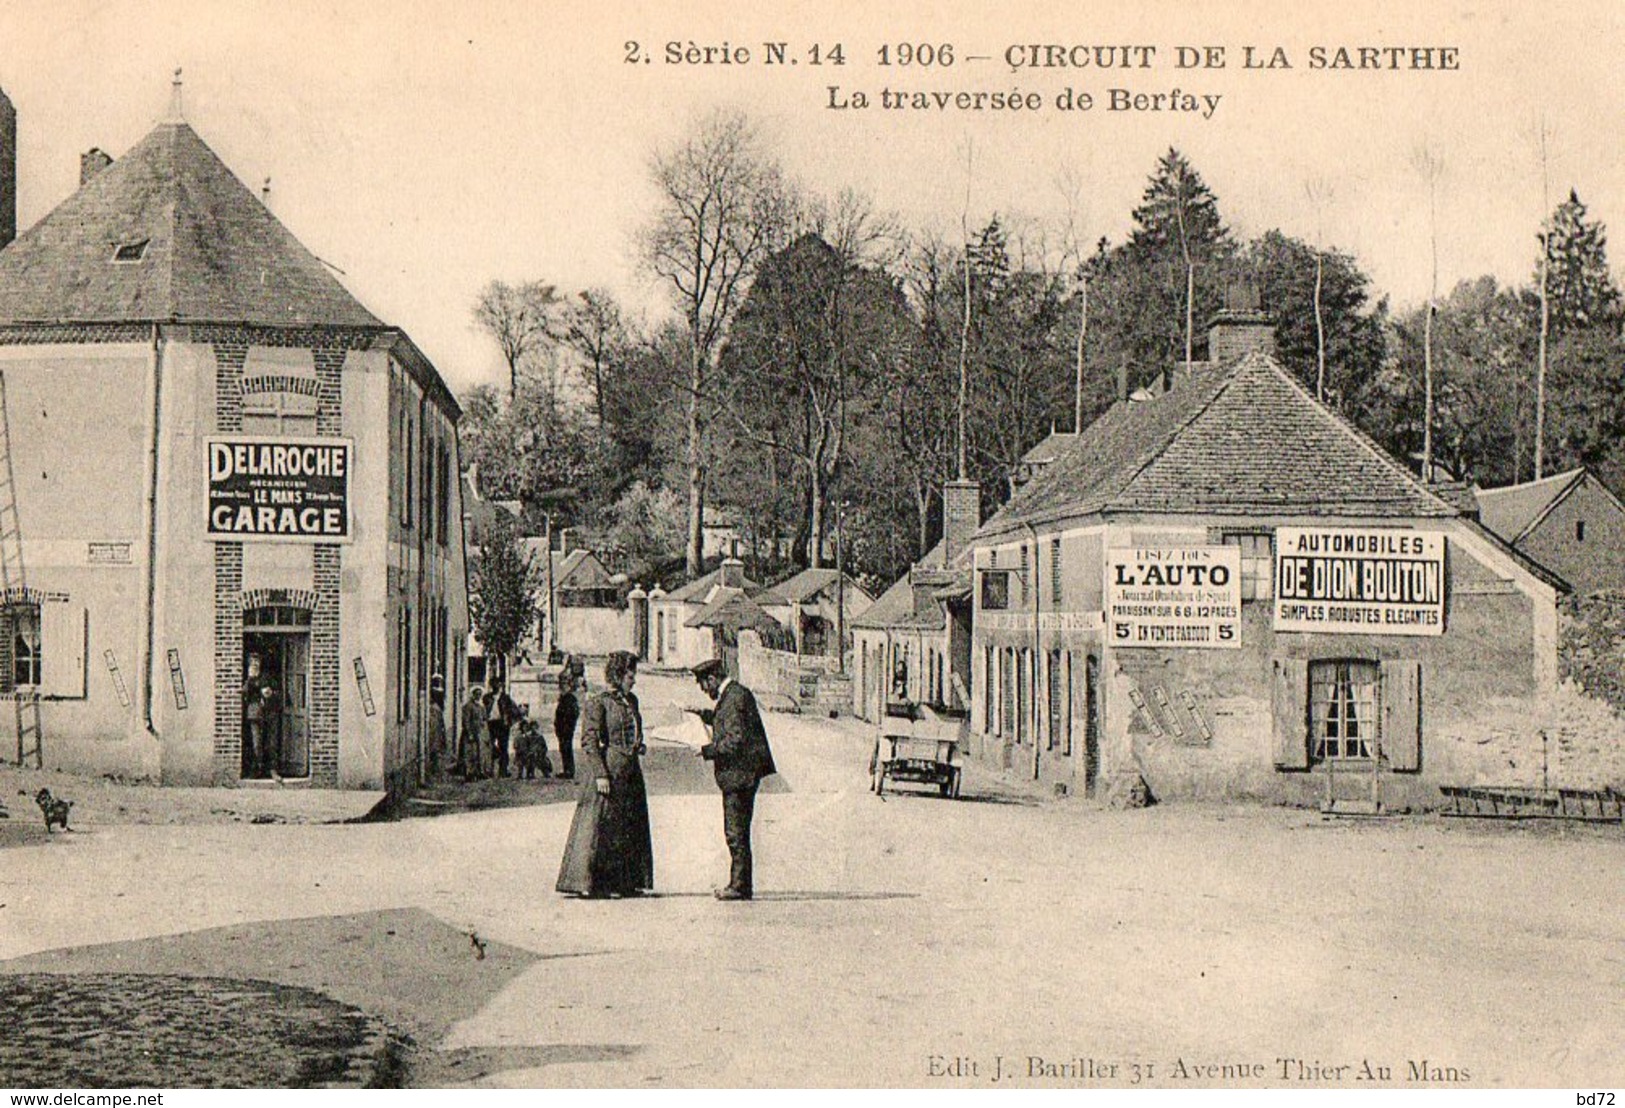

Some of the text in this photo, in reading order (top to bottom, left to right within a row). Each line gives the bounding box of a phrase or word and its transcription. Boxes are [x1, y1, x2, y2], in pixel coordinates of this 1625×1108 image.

[210, 443, 344, 482] DELAROCHE
[254, 488, 268, 504] LE
[271, 489, 302, 505] MANS
[212, 504, 341, 533] GARAGE
[1298, 534, 1424, 555] AUTOMOBILES
[1115, 564, 1230, 587] L'AUTO
[1282, 557, 1309, 599] DE
[1197, 606, 1210, 618] 12
[1211, 606, 1237, 618] PAGES
[1115, 622, 1130, 639] 5
[1218, 624, 1234, 640] 5
